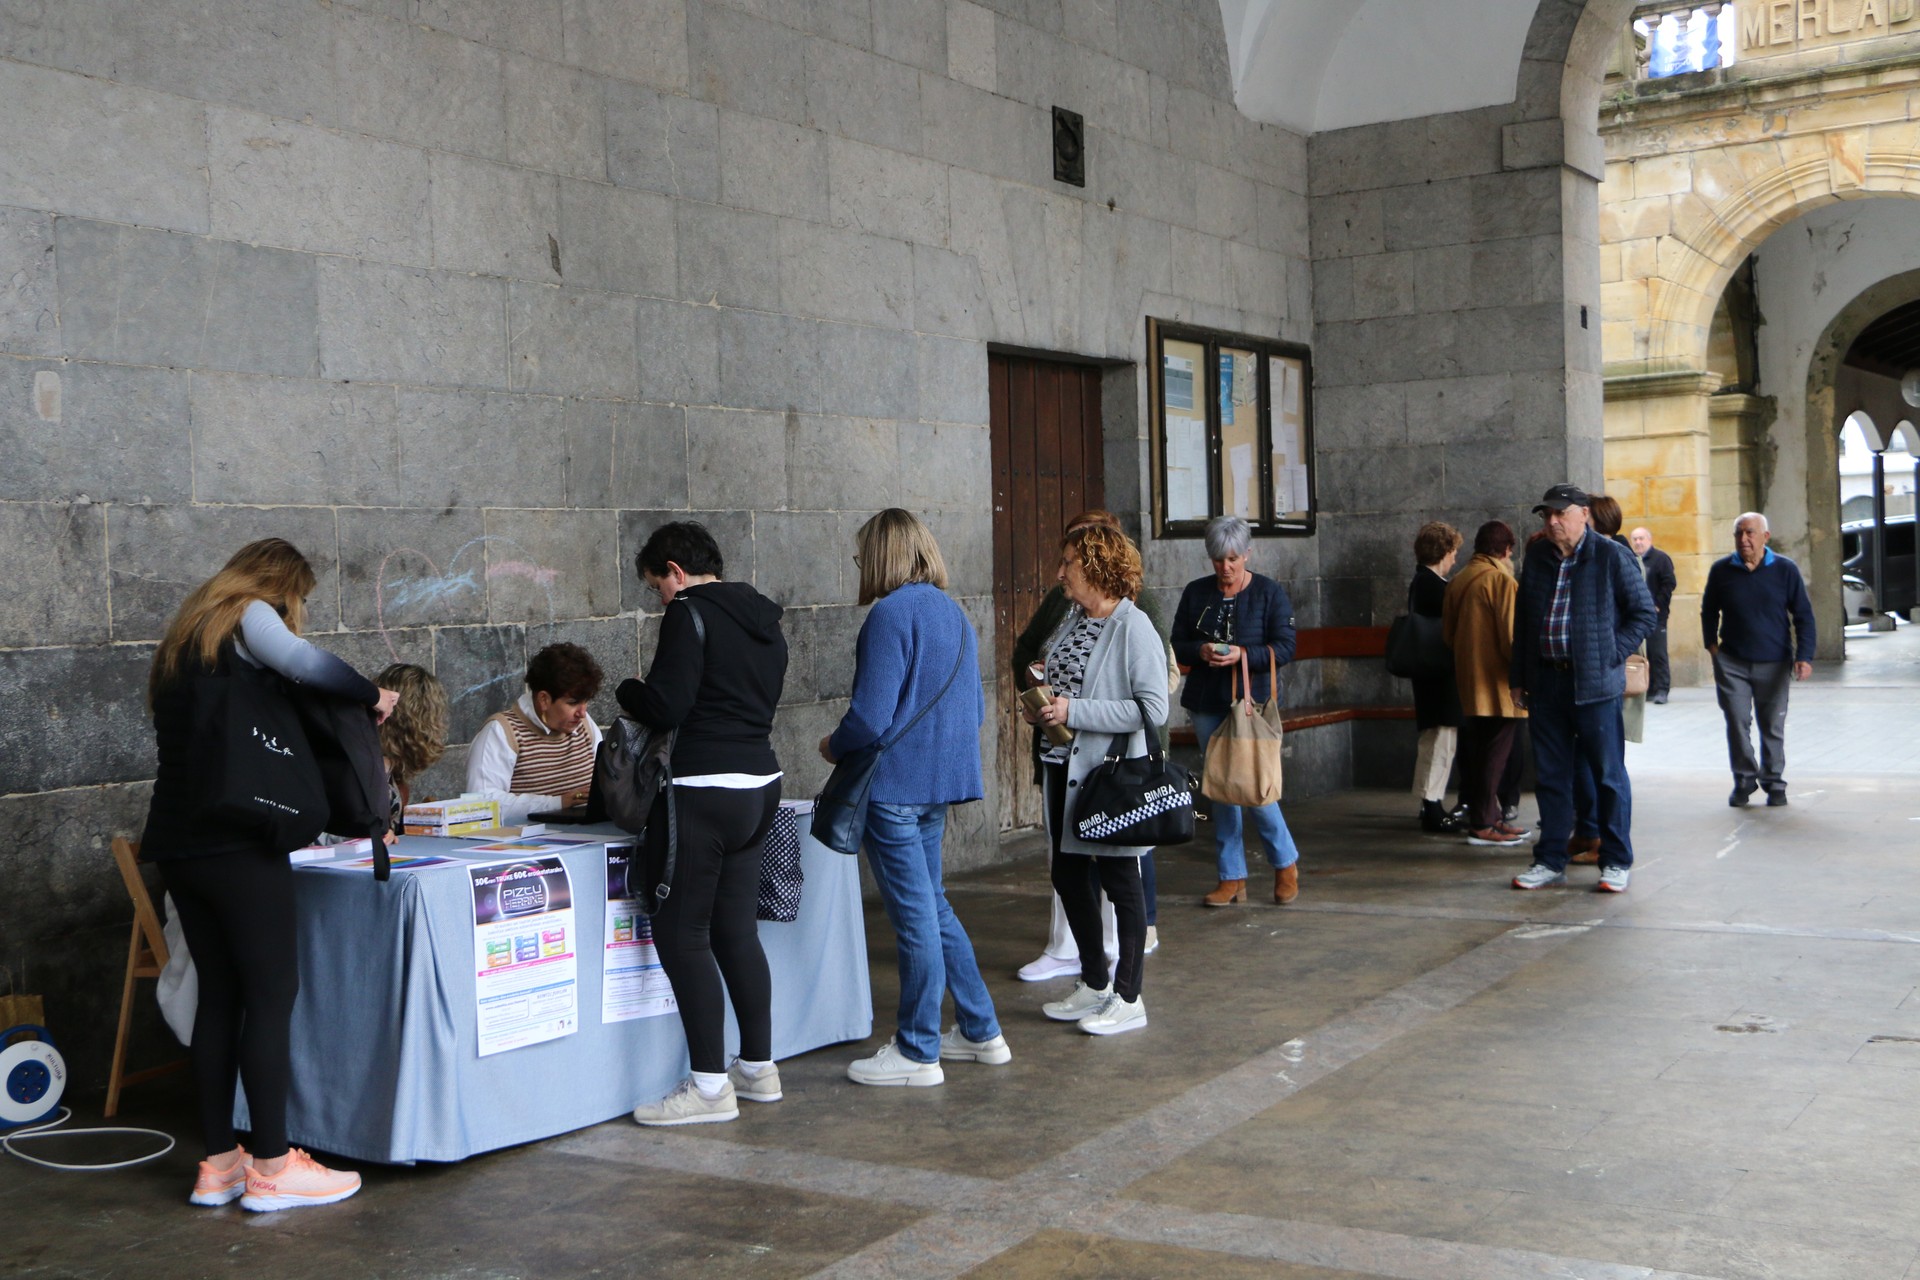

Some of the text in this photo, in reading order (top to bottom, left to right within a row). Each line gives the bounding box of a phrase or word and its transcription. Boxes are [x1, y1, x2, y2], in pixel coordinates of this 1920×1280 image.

[1144, 783, 1177, 803] BIMBA
[1079, 811, 1109, 832] BIMBA
[514, 870, 528, 880] 60€
[252, 1180, 277, 1192] HOKA
